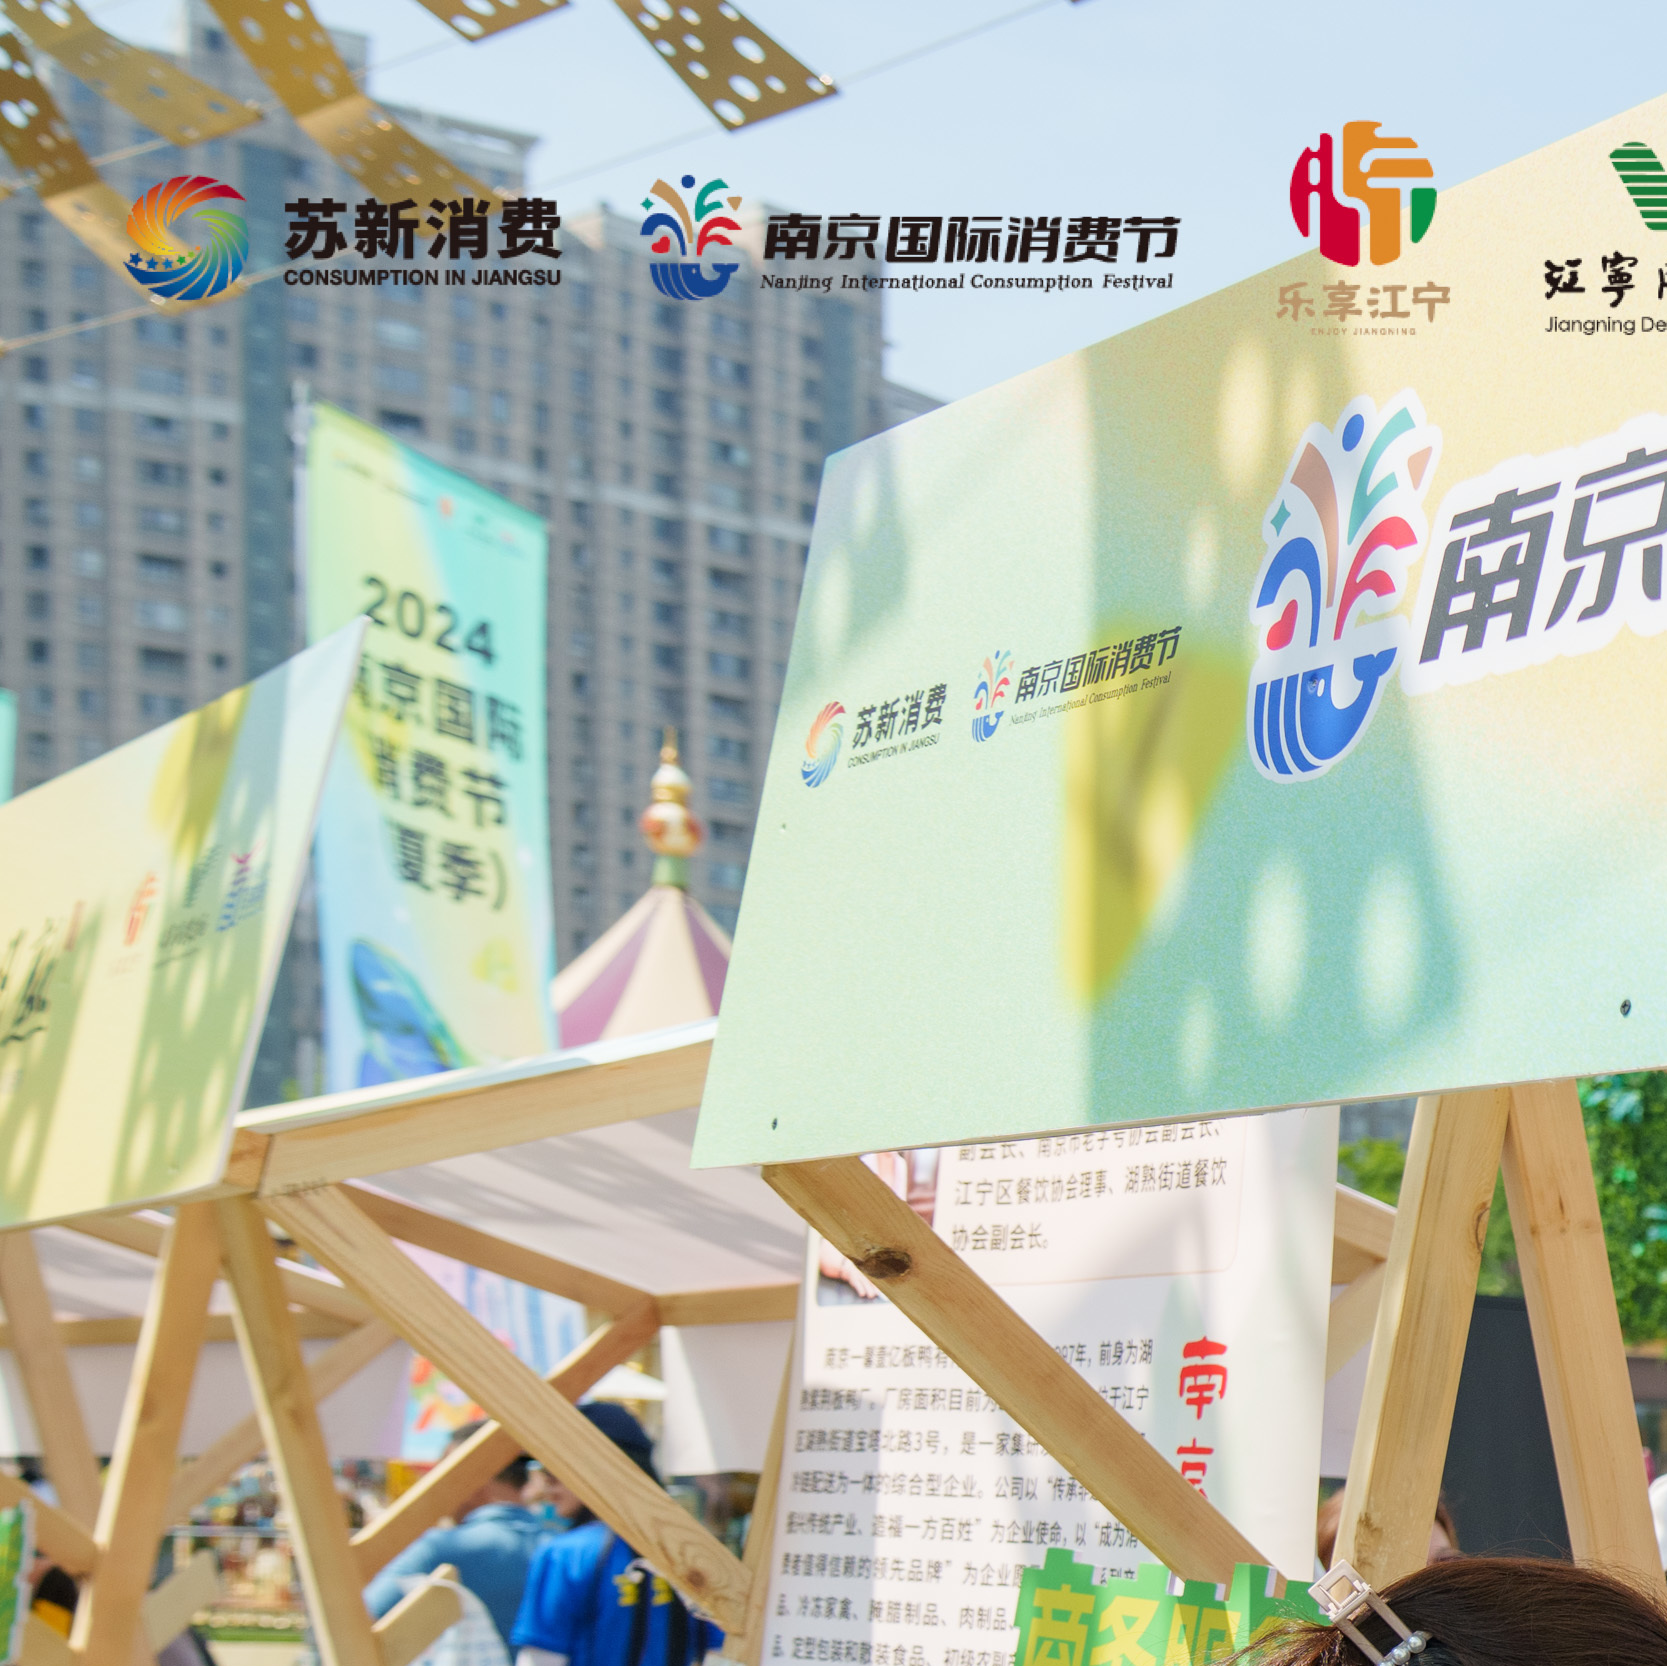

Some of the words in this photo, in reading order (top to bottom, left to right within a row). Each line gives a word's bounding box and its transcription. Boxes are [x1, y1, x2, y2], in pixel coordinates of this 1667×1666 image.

[362, 575, 497, 666] 2024
[1014, 625, 1183, 705] 南京国际消费节
[847, 744, 896, 769] CONSUMPTION
[908, 733, 940, 753] JIANGSU
[852, 682, 948, 750] 苏新消费
